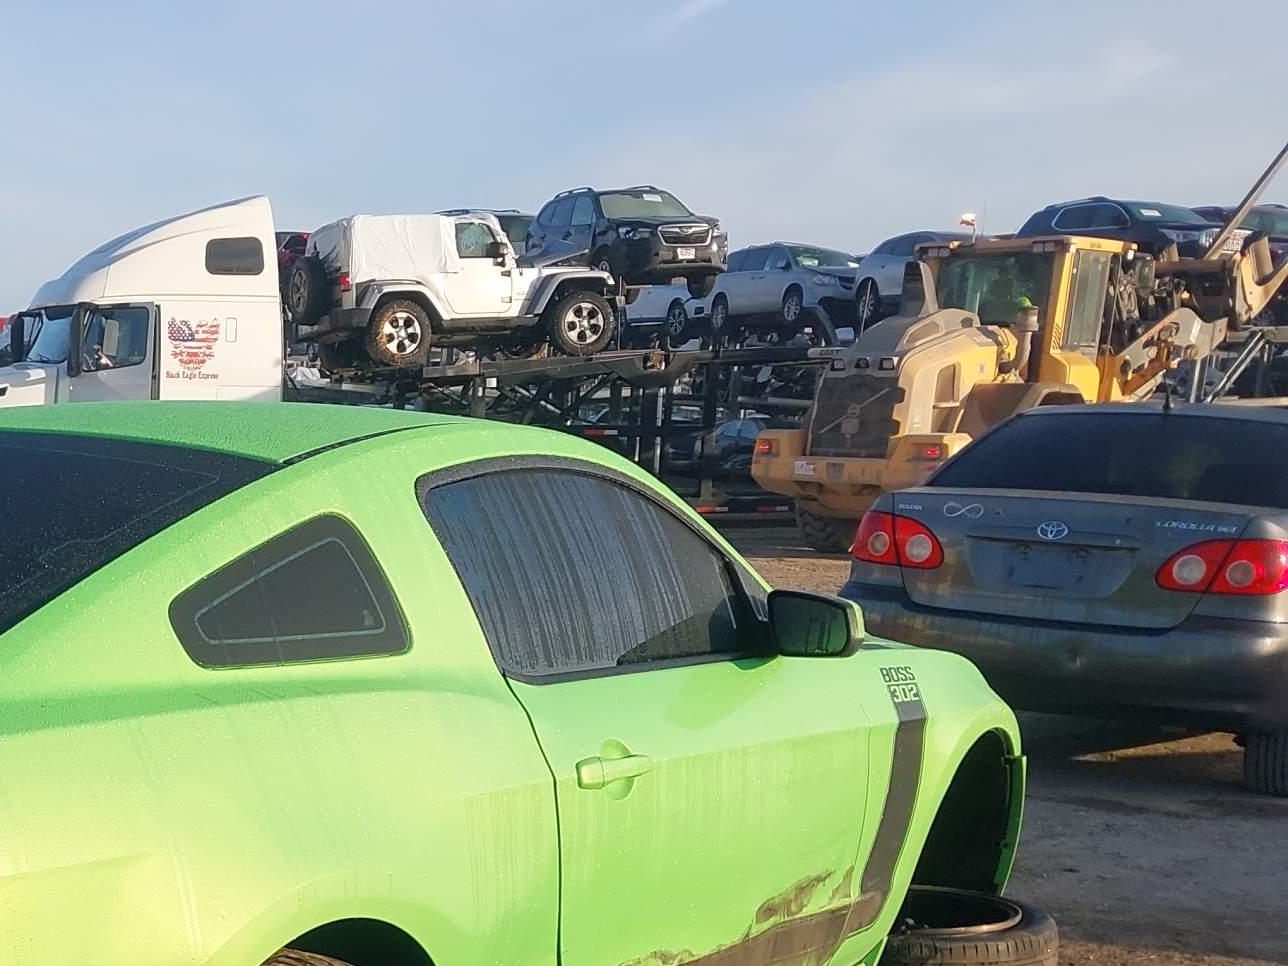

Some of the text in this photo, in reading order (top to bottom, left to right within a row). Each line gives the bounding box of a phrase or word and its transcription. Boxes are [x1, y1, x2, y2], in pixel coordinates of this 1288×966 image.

[182, 371, 196, 380] Eagle
[198, 371, 219, 380] Express
[879, 666, 916, 683] BOSS
[889, 684, 920, 703] 302
